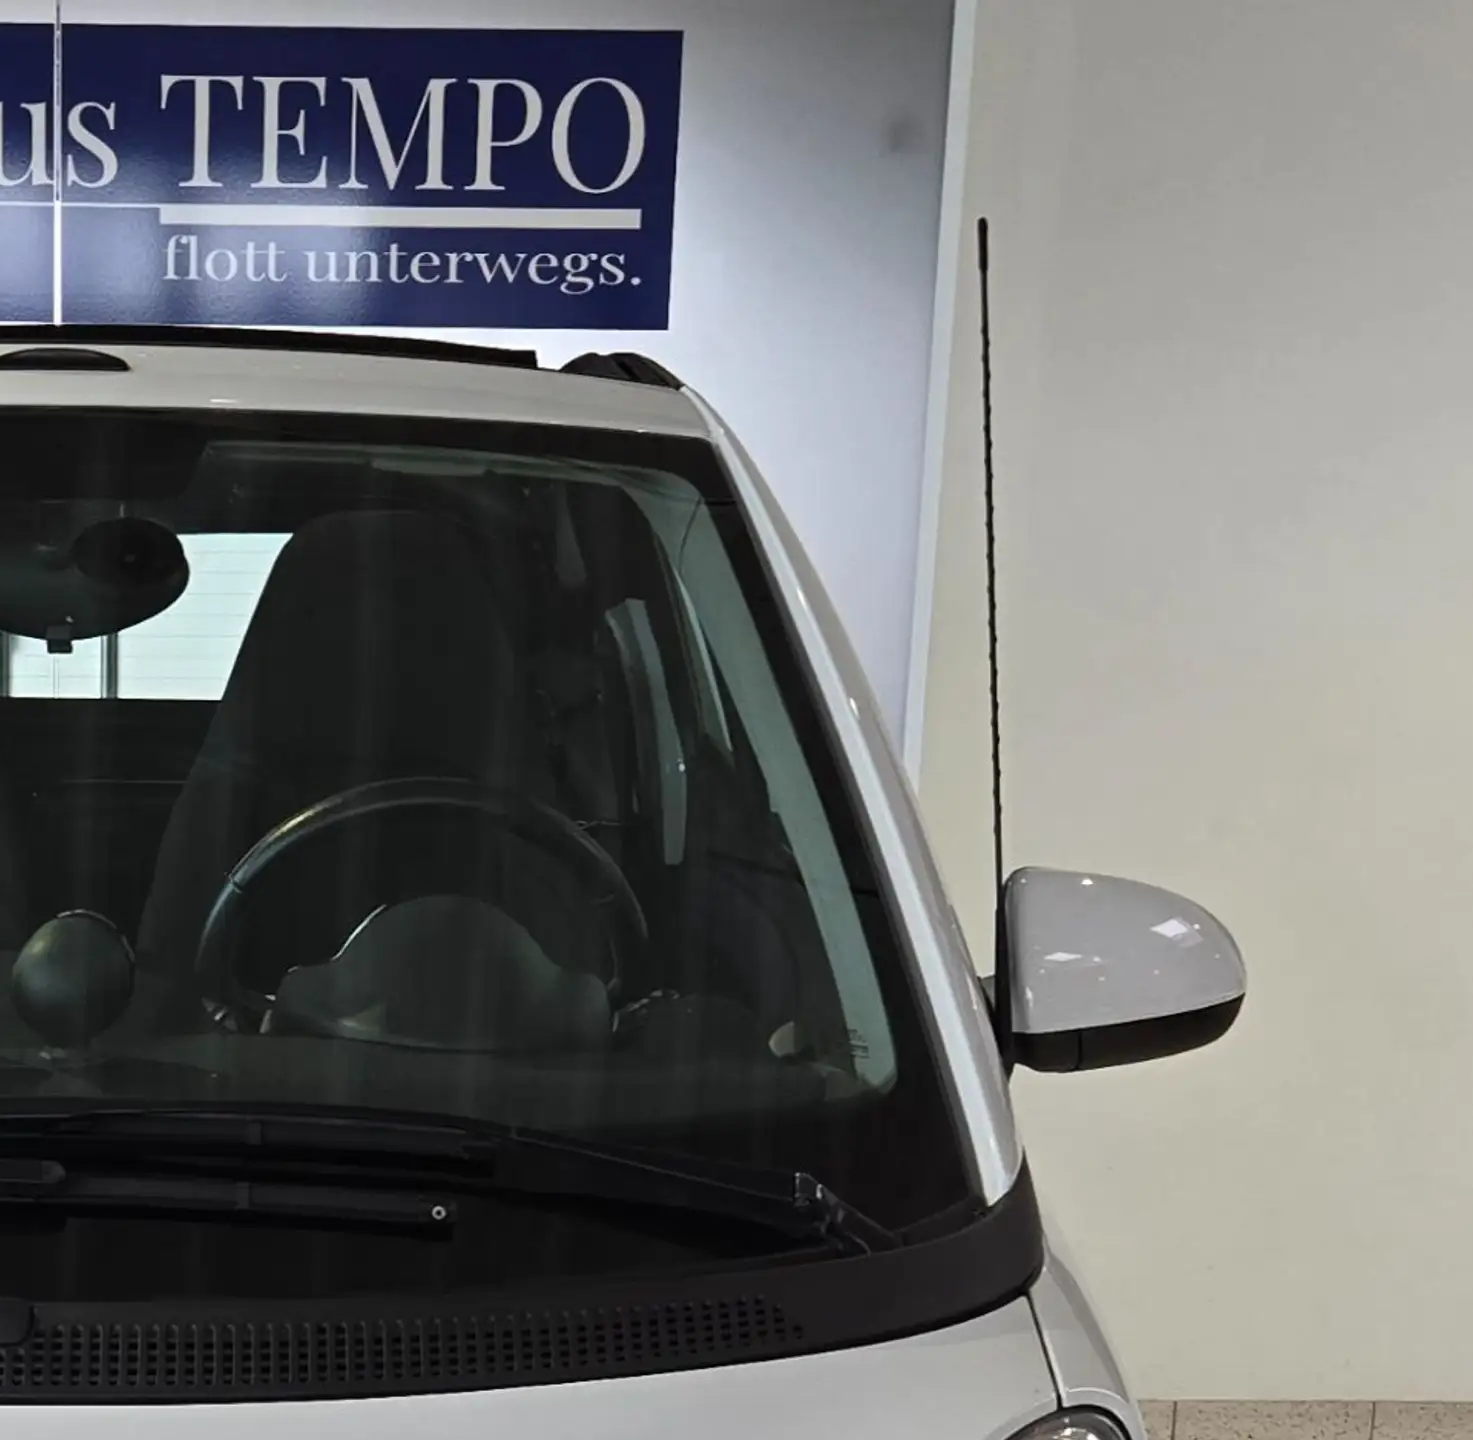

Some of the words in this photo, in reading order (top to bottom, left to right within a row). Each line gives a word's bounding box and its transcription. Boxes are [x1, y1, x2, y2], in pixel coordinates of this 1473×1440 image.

[160, 73, 646, 194] TEMPO
[162, 234, 288, 281] flott
[305, 241, 642, 295] unterwegs.
